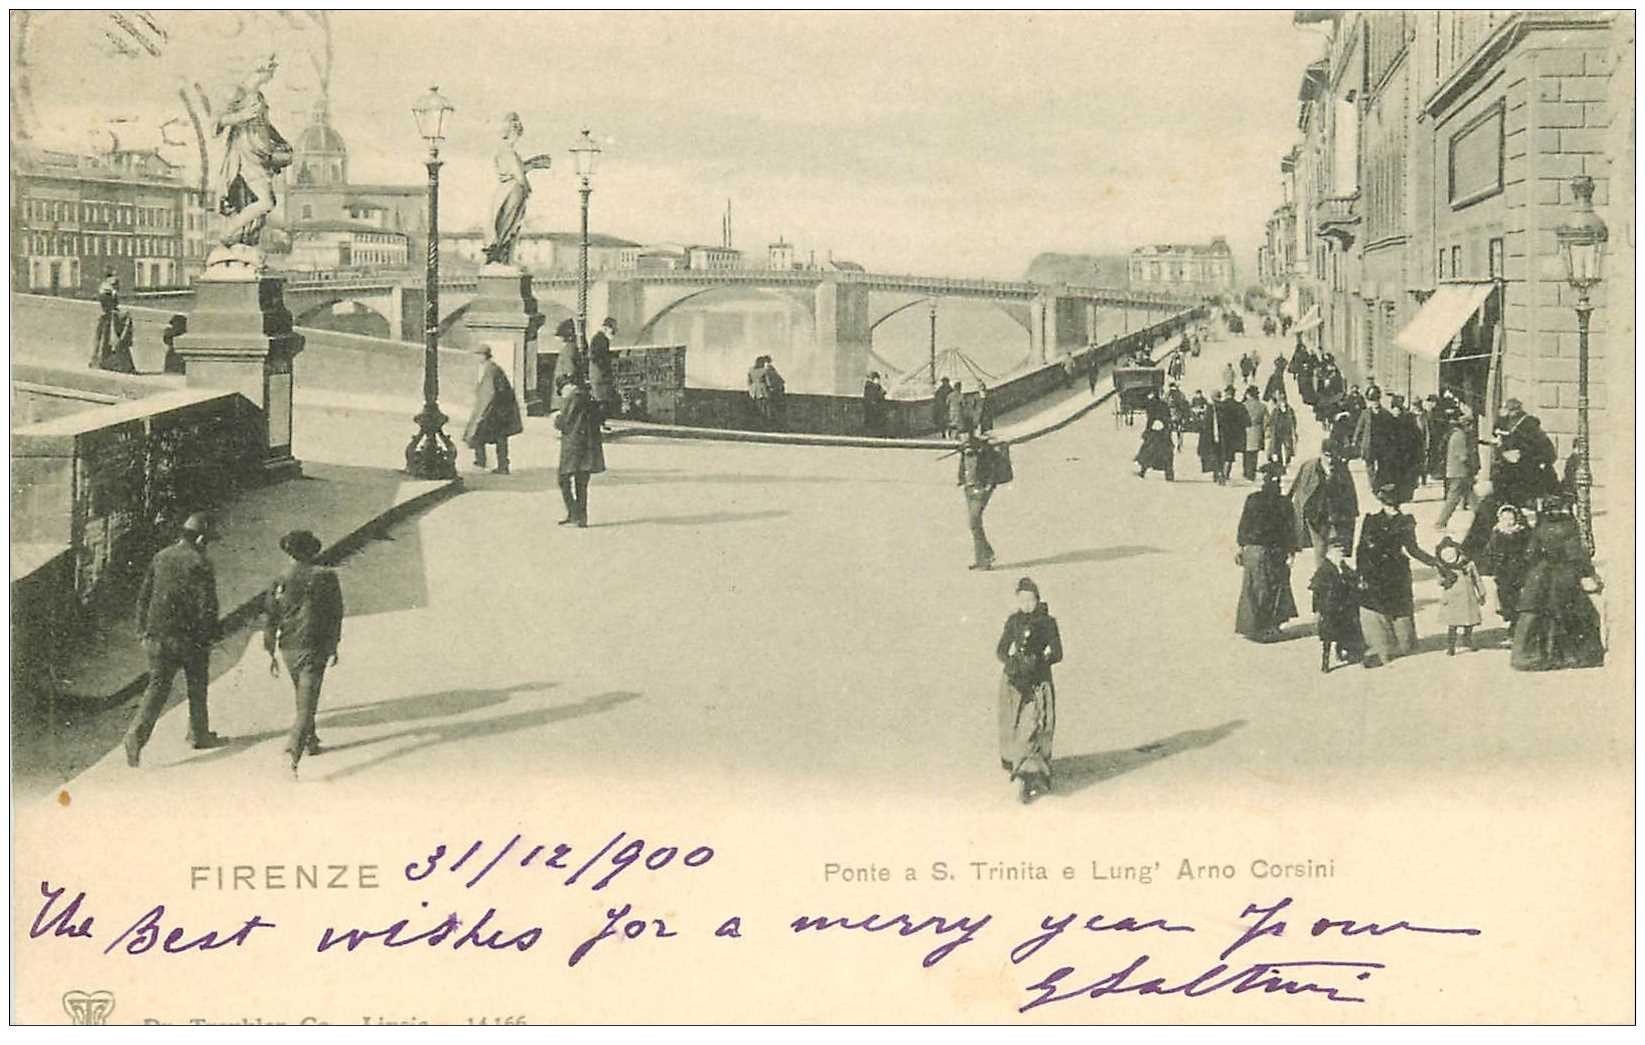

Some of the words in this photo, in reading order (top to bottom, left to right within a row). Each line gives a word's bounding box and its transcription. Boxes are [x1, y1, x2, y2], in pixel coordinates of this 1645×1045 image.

[404, 831, 715, 891] 31/12/900
[103, 904, 276, 955] Best
[316, 901, 543, 952] wishes
[714, 916, 742, 938] a
[790, 913, 993, 969] merry
